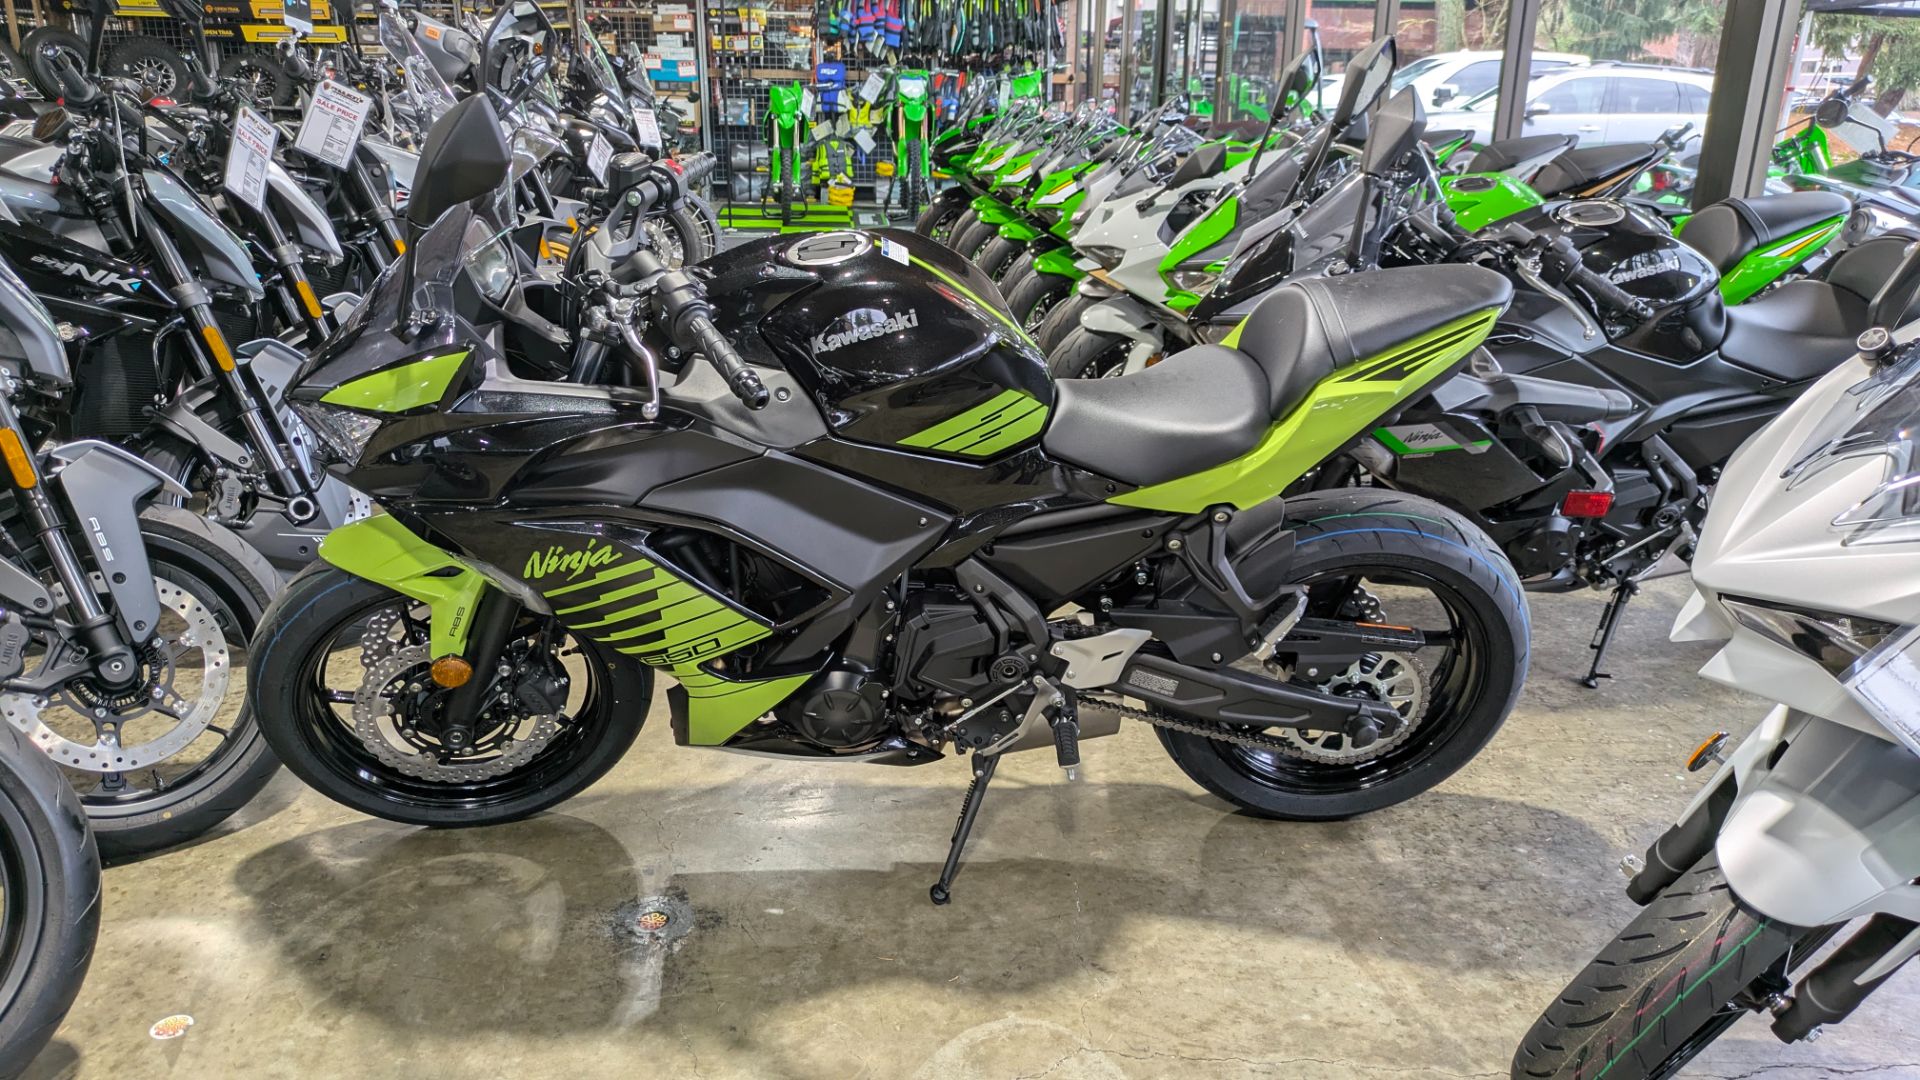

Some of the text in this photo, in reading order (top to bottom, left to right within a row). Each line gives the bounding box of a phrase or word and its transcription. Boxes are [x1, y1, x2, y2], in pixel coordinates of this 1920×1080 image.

[316, 98, 336, 112] SALE
[336, 107, 359, 121] PRICE
[237, 127, 251, 144] SALE
[252, 140, 268, 156] PRICE
[809, 308, 918, 354] Kawasaki
[1403, 429, 1443, 444] Ninja
[88, 516, 115, 562] ABS
[523, 538, 623, 581] Ninja
[449, 606, 466, 638] ABS
[641, 637, 722, 665] 650
